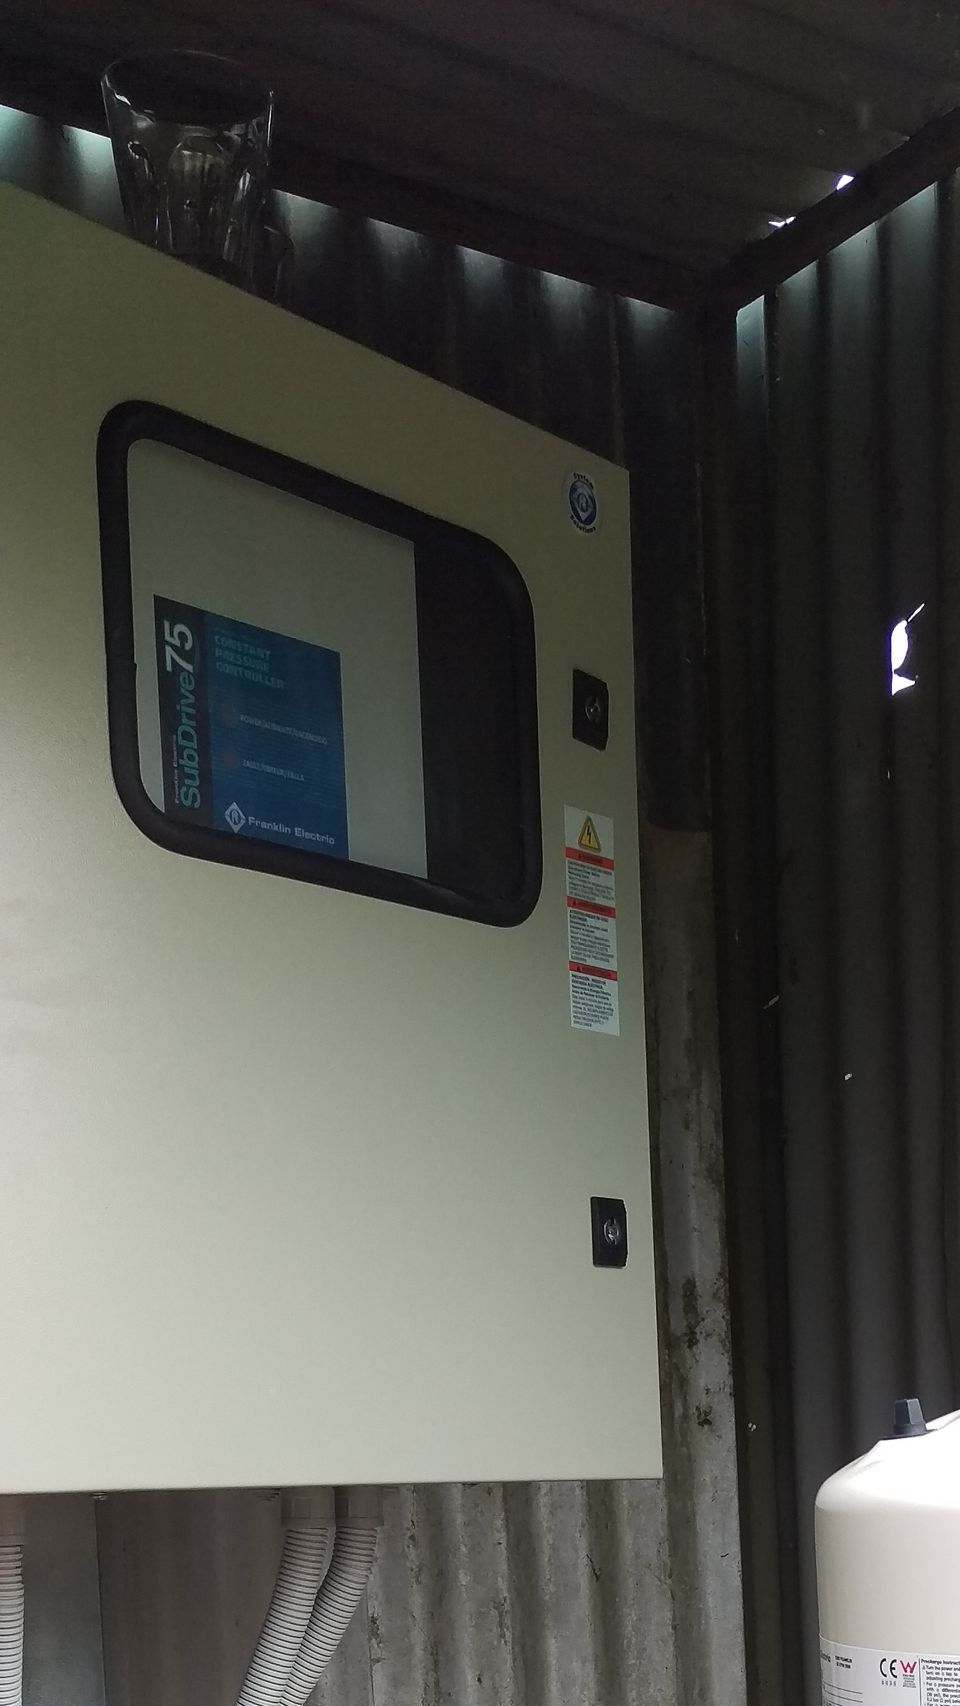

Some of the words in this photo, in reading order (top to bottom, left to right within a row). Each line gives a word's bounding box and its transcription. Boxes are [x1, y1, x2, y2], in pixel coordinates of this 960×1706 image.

[214, 635, 271, 660] CONSTANT
[215, 648, 270, 672] PRESSURE
[216, 661, 284, 689] CONTROLLER
[248, 816, 291, 835] Franklin
[294, 827, 336, 845] Electric
